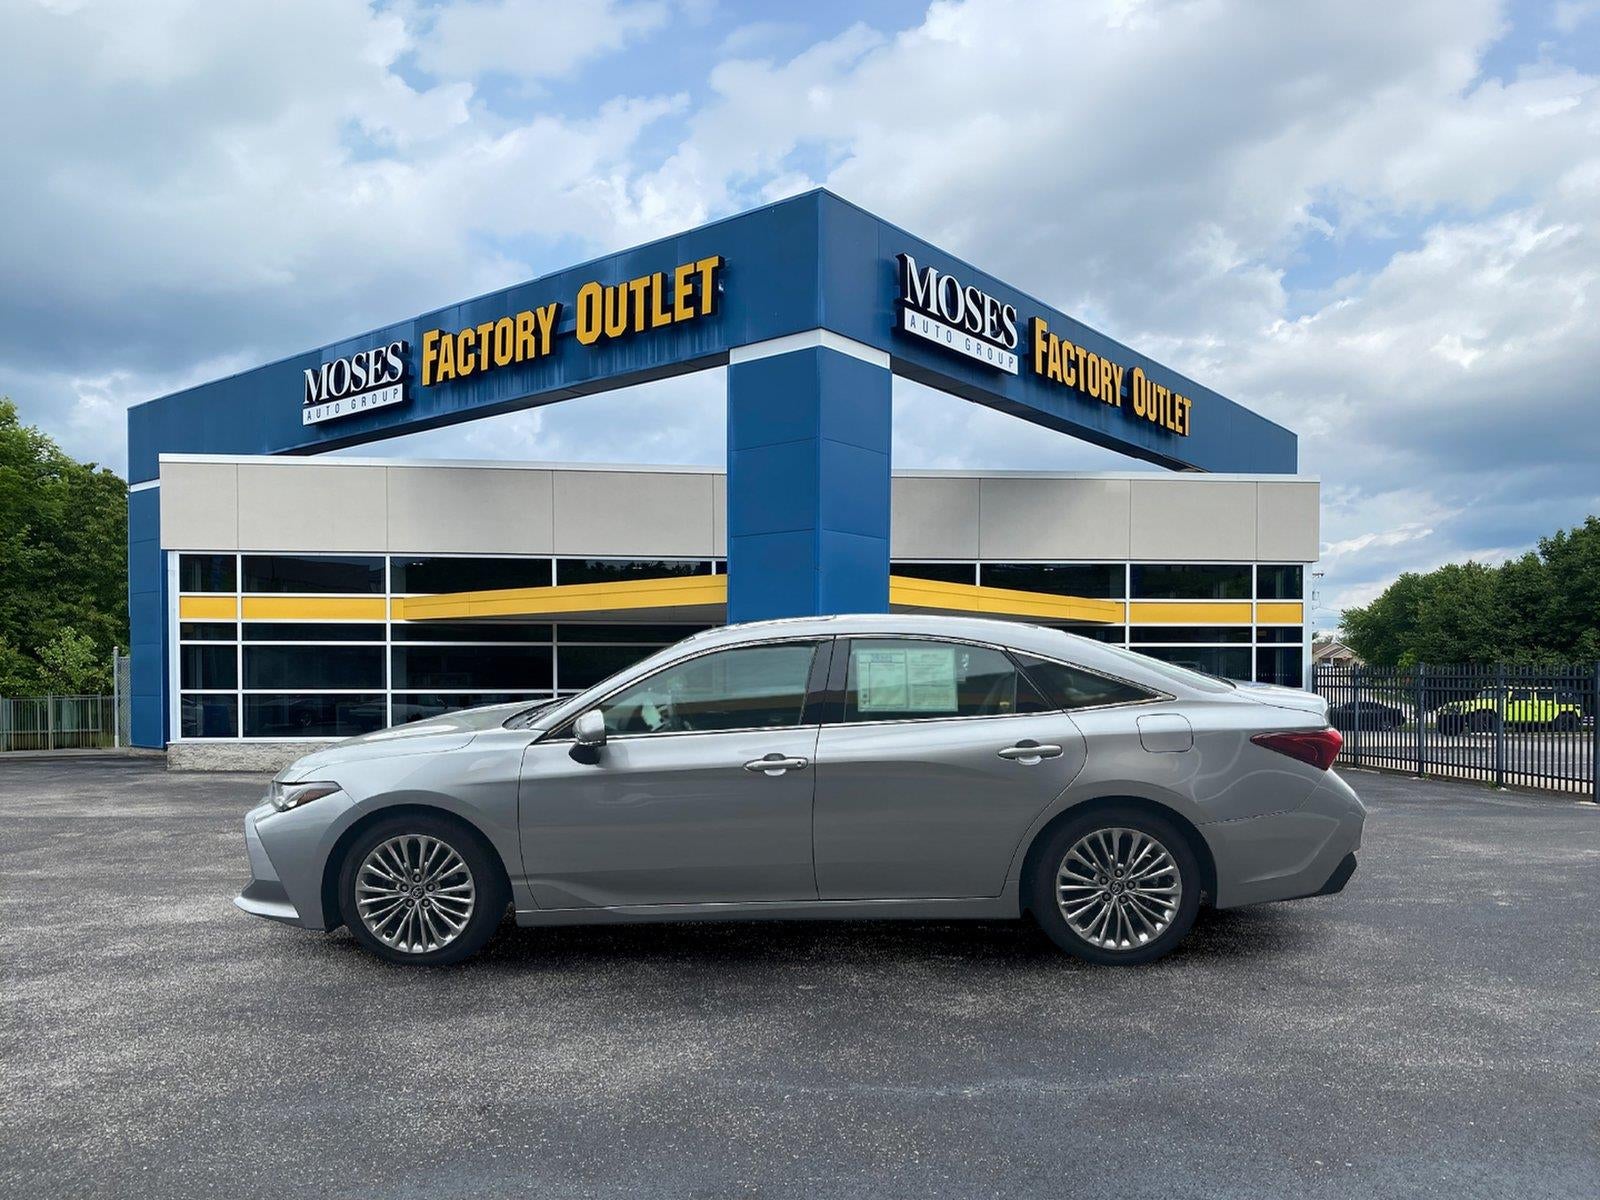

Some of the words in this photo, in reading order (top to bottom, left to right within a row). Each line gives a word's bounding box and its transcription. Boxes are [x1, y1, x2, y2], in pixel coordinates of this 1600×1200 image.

[422, 303, 558, 386] FACTORY
[576, 255, 720, 346] OUTLET
[904, 253, 1018, 350] MOSES
[910, 314, 952, 343] AUTO
[965, 338, 1014, 368] GROUP
[303, 342, 403, 405] MOSES
[307, 403, 340, 421] AUTO
[351, 388, 398, 410] GROUP
[1035, 316, 1124, 407] FACTORY
[1133, 367, 1192, 437] OUTLET
